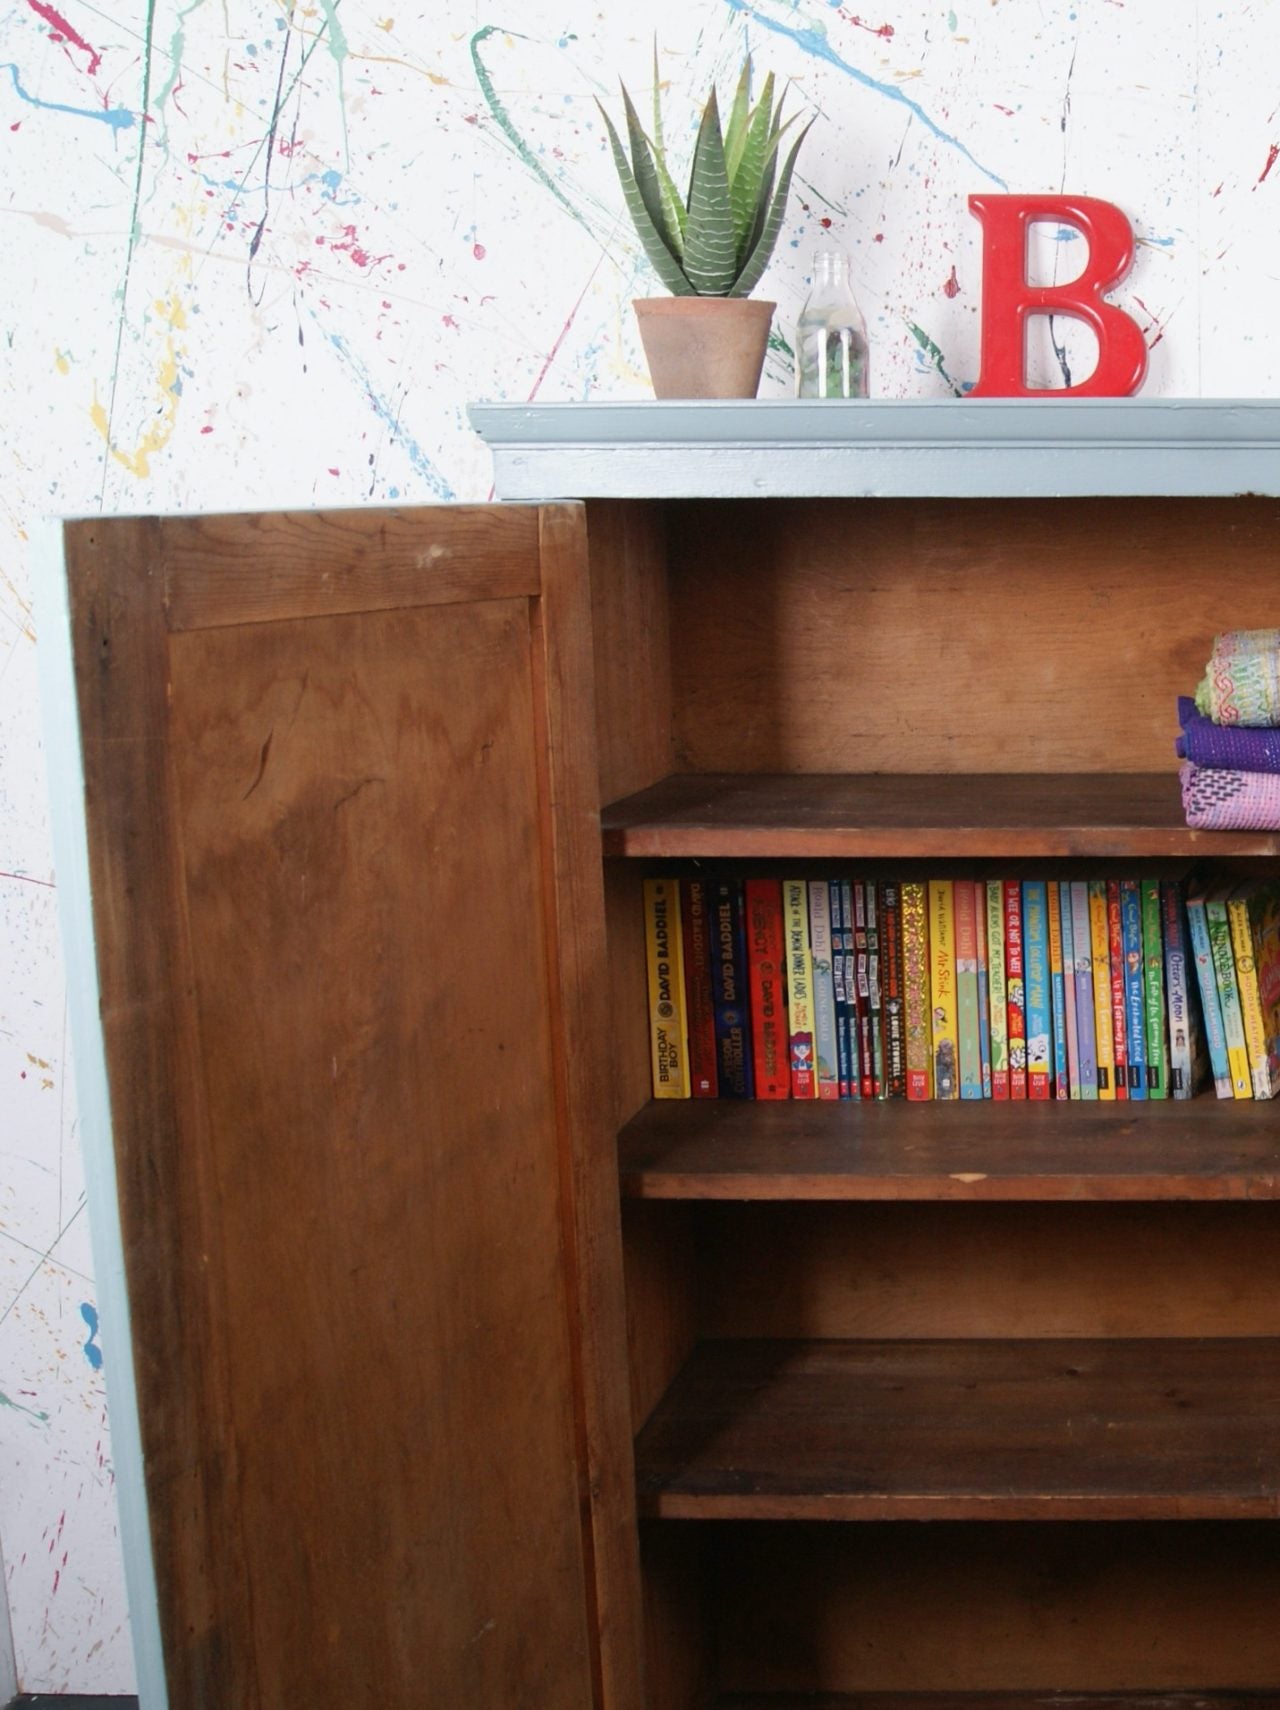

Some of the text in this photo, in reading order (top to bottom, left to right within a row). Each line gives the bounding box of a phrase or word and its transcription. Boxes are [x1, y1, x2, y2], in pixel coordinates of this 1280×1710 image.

[962, 194, 1148, 397] B
[690, 884, 702, 915] DAVID
[813, 887, 825, 918] Roald
[990, 887, 1000, 904] BABY
[1008, 898, 1019, 913] WEE
[991, 905, 1000, 928] ALIENS
[1009, 915, 1019, 926] OR
[655, 900, 671, 1001] DAVID BADDIEL
[792, 930, 803, 951] DEMON
[814, 925, 826, 952] Dahl
[992, 931, 1000, 945] GOT
[1009, 929, 1020, 943] NOT
[719, 903, 735, 1000] DAVID BADDIEL
[938, 950, 949, 966] Mr
[762, 980, 774, 1017] DAVID
[794, 978, 806, 1000] LADIES
[937, 970, 950, 999] Stink
[1220, 971, 1233, 1002] BOOK
[1244, 975, 1254, 1012] HOLIDAY
[1171, 992, 1185, 1022] Moon
[657, 1028, 670, 1083] BIRTHDAY
[668, 1042, 678, 1068] BOY
[891, 1016, 900, 1076] LOUIE STOWELL
